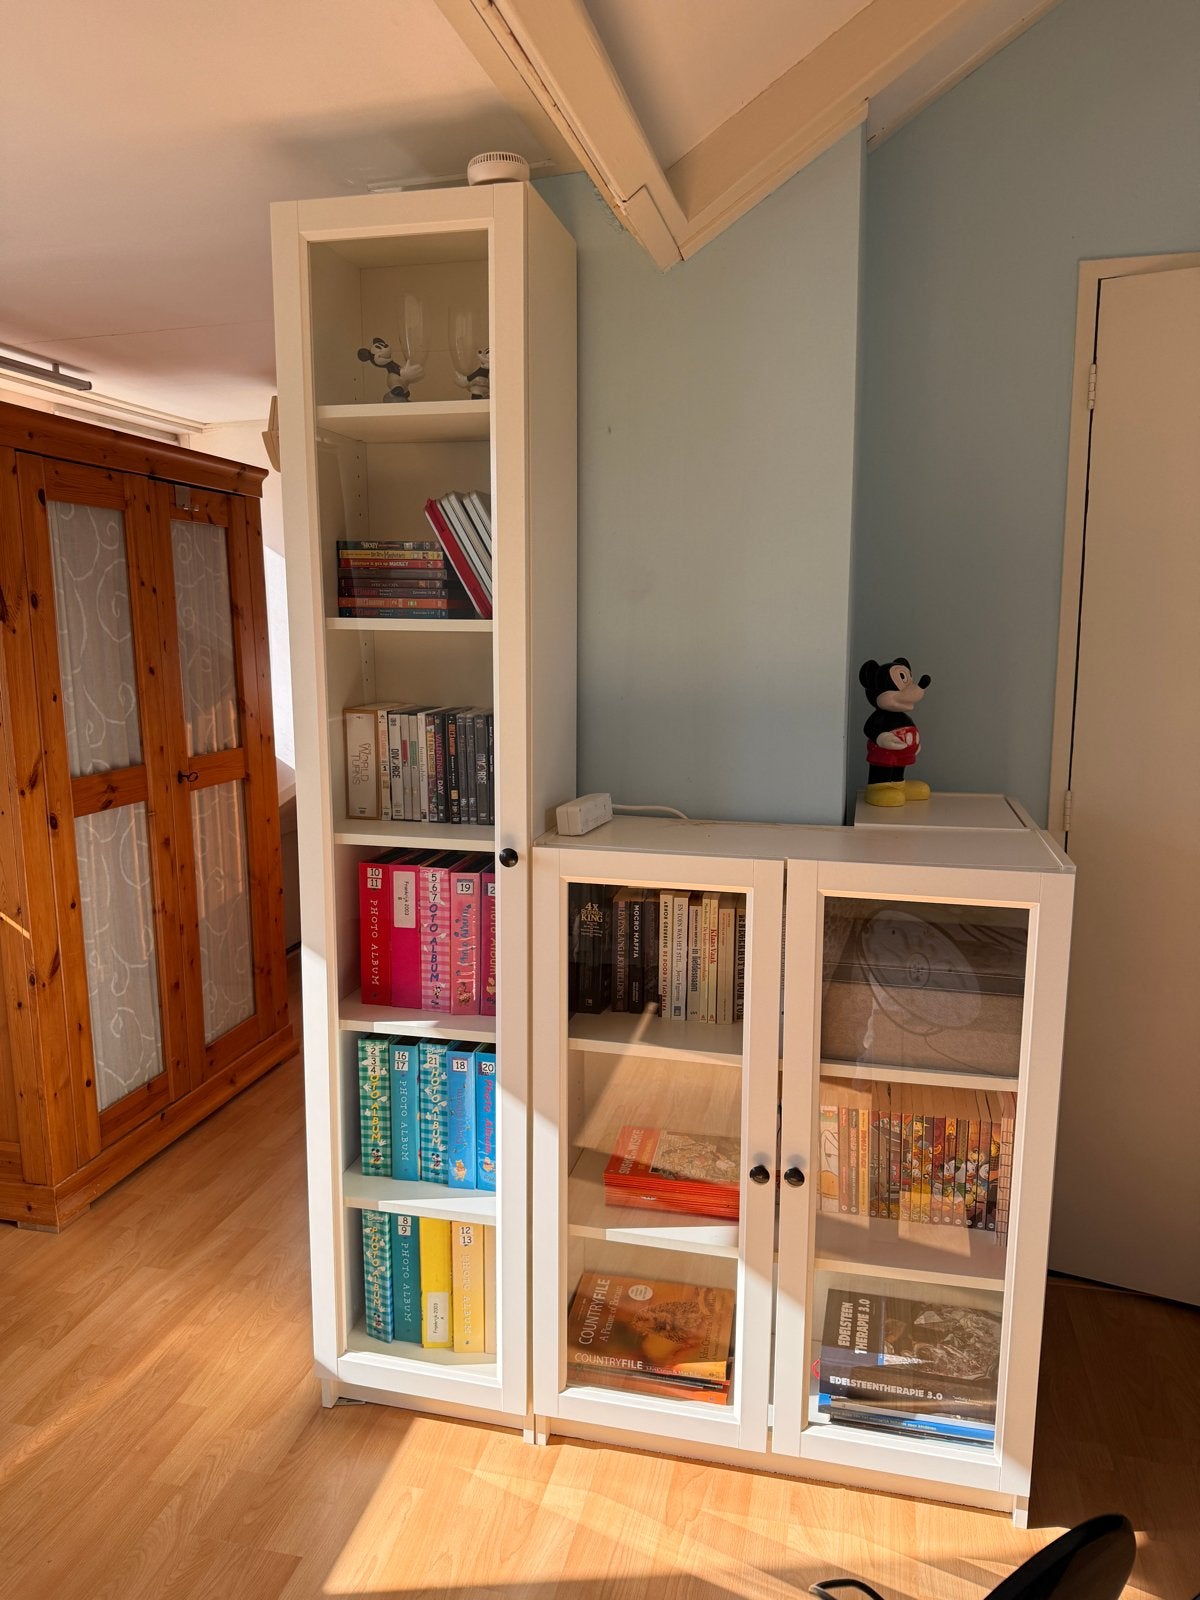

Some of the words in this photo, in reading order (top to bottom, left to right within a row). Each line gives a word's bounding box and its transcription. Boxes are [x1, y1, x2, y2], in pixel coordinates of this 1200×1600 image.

[351, 754, 361, 785] TURNS
[361, 743, 372, 782] WORLD
[370, 868, 381, 877] 10
[370, 879, 379, 887] 11
[431, 873, 437, 882] 5
[431, 893, 438, 902] 7
[432, 883, 438, 892] 6
[460, 883, 470, 892] 19
[581, 913, 603, 923] KING
[677, 904, 684, 912] EN
[370, 900, 378, 939] PHOTO
[371, 943, 380, 986] ALBUM
[430, 938, 440, 982] ALBUM
[691, 955, 700, 993] liefdesnaam
[370, 1047, 376, 1055] 2
[371, 1057, 377, 1065] 3
[396, 1051, 407, 1060] 16
[428, 1057, 437, 1066] 21
[370, 1066, 377, 1074] 4
[396, 1061, 405, 1070] 17
[455, 1061, 465, 1070] 18
[482, 1063, 494, 1072] 20
[399, 1080, 408, 1117] PHOTO
[484, 1079, 494, 1113] Photo
[370, 1102, 381, 1142] ALBUM
[431, 1106, 441, 1147] ALBUM
[400, 1123, 409, 1161] ALBUM
[484, 1118, 494, 1155] Album
[401, 1227, 407, 1235] 9
[403, 1217, 409, 1225] 8
[461, 1227, 471, 1235] 12
[370, 1227, 379, 1267] PHOTO
[462, 1236, 472, 1244] 13
[401, 1243, 409, 1281] PHOTO
[462, 1254, 471, 1293] PHOTO
[372, 1269, 382, 1307] ALBUM
[403, 1283, 412, 1323] ALBUM
[578, 1278, 610, 1345] COUNTRYFILE
[859, 1298, 871, 1315] 3.0
[463, 1296, 473, 1336] ALBUM
[601, 1313, 615, 1335] Picture
[838, 1302, 854, 1348] EDELSTEEN
[854, 1313, 870, 1355] THERAPIE
[574, 1352, 643, 1370] COUNTRYFILE
[829, 1375, 925, 1398] EDELSTEENTHERAPIE
[926, 1391, 943, 1401] 3.0
